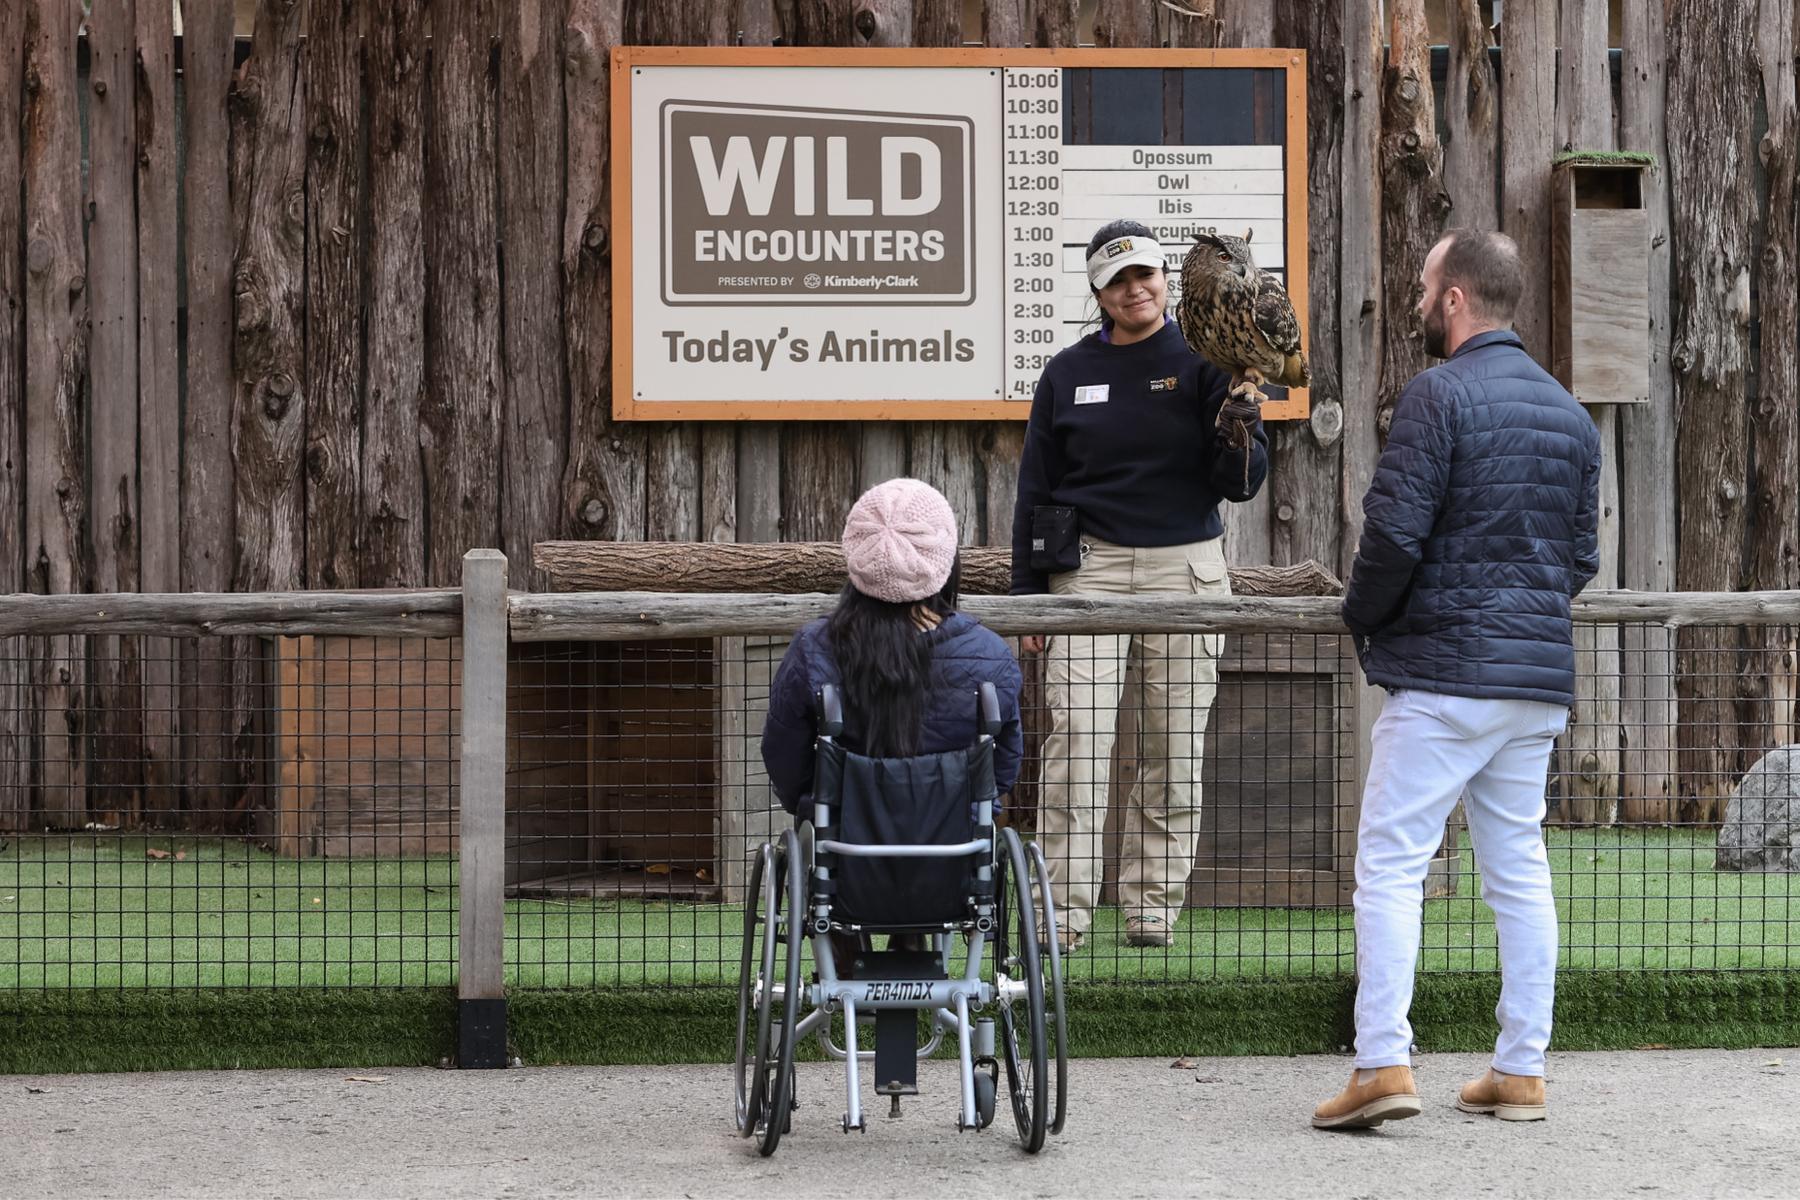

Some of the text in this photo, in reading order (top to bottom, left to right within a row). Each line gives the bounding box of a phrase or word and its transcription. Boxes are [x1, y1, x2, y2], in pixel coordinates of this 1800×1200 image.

[1007, 73, 1059, 89] 10:00
[1007, 99, 1059, 114] 10:30
[1007, 125, 1059, 140] 11:00
[1007, 150, 1059, 165] 11:30
[1132, 149, 1213, 168] Opossum
[689, 136, 942, 216] WILD
[1007, 176, 1059, 191] 12:00
[1157, 174, 1190, 190] Owl
[1007, 201, 1059, 216] 12:30
[1158, 199, 1193, 215] Ibis
[1013, 227, 1054, 242] 1:00
[1152, 222, 1217, 242] rcupine
[695, 230, 945, 262] ENCOUNTERS
[1013, 252, 1054, 267] 1:30
[717, 275, 919, 290] PRESENTED BY Kimberly-Clark
[1013, 278, 1054, 293] 2:00
[1013, 303, 1054, 318] 2:30
[1013, 329, 1054, 344] 3:00
[661, 327, 975, 371] Today’s Animals
[864, 982, 934, 1001] PER4MAX
